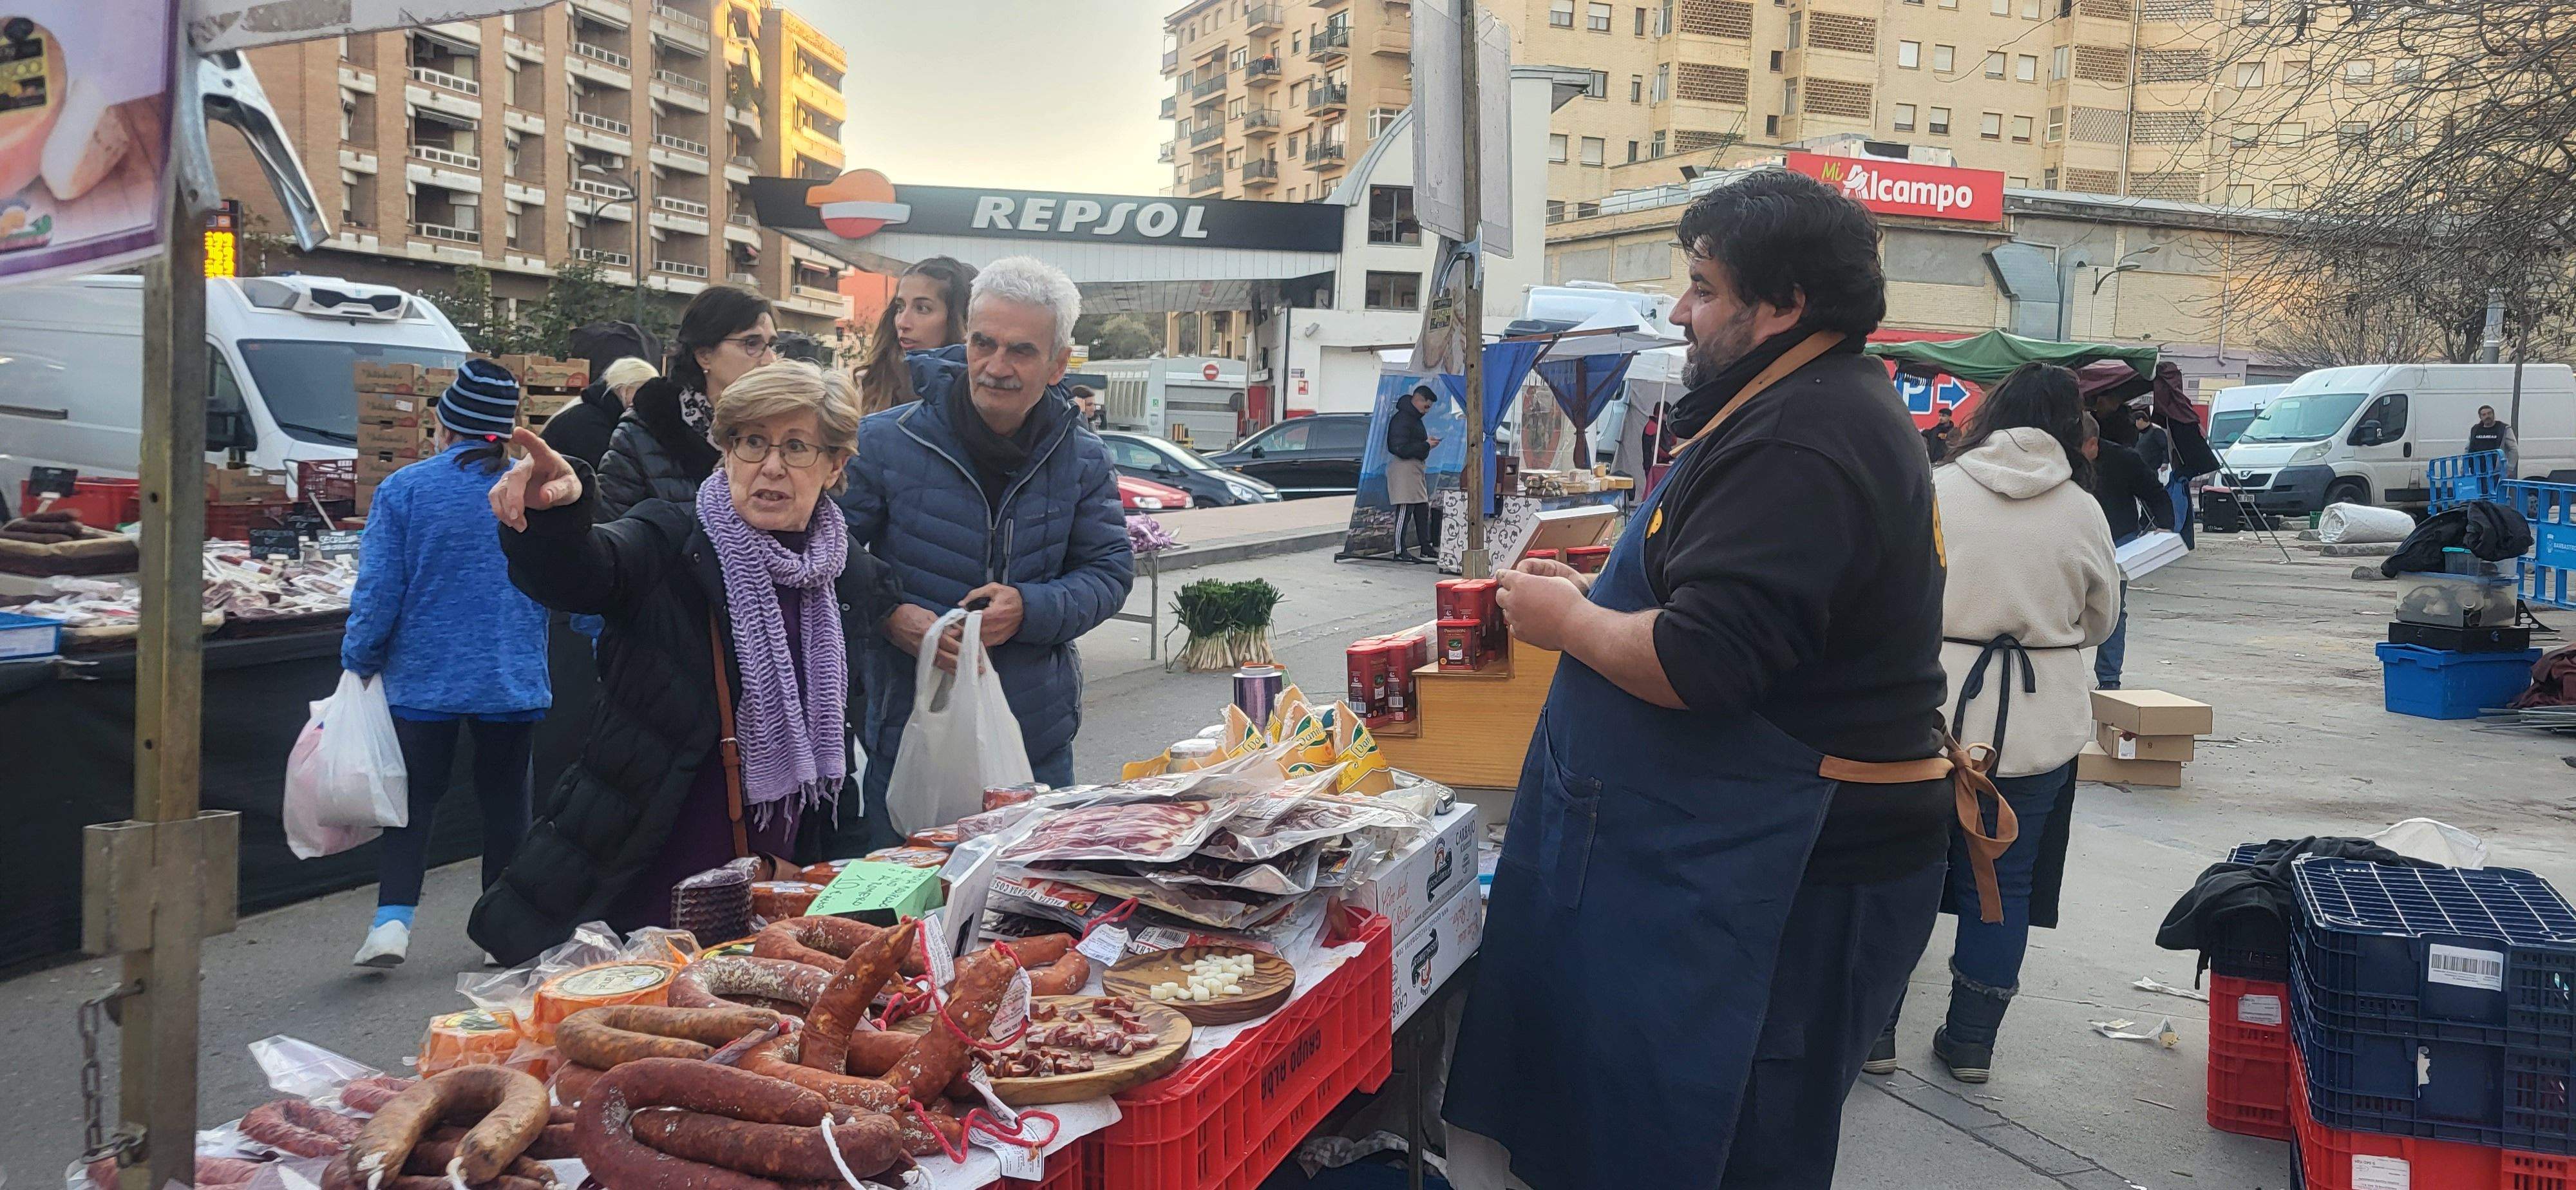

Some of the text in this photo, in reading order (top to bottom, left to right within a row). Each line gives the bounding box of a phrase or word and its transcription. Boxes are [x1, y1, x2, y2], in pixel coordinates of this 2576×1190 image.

[1821, 161, 1973, 212] Mi Alcampo
[971, 196, 1208, 239] REPSOL
[1039, 895, 1064, 906] PALETA
[1392, 992, 1408, 1019] CARB
